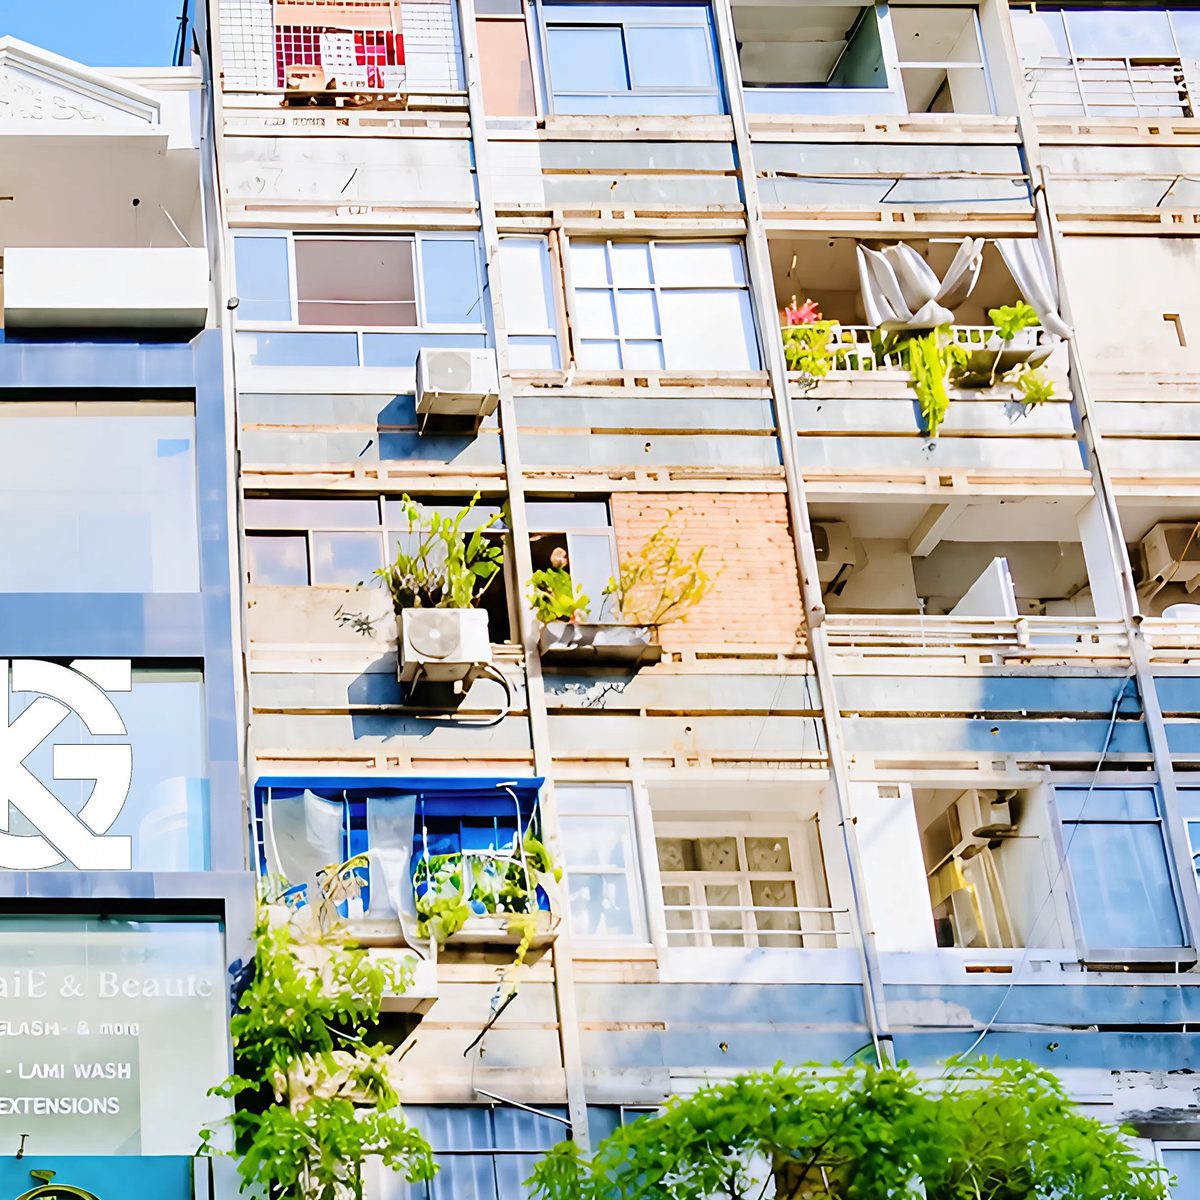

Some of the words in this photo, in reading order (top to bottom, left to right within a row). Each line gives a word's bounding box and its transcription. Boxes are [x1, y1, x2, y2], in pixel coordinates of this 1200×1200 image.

[59, 975, 85, 999] &
[18, 1062, 65, 1080] LAMI
[73, 1062, 132, 1080] WASH
